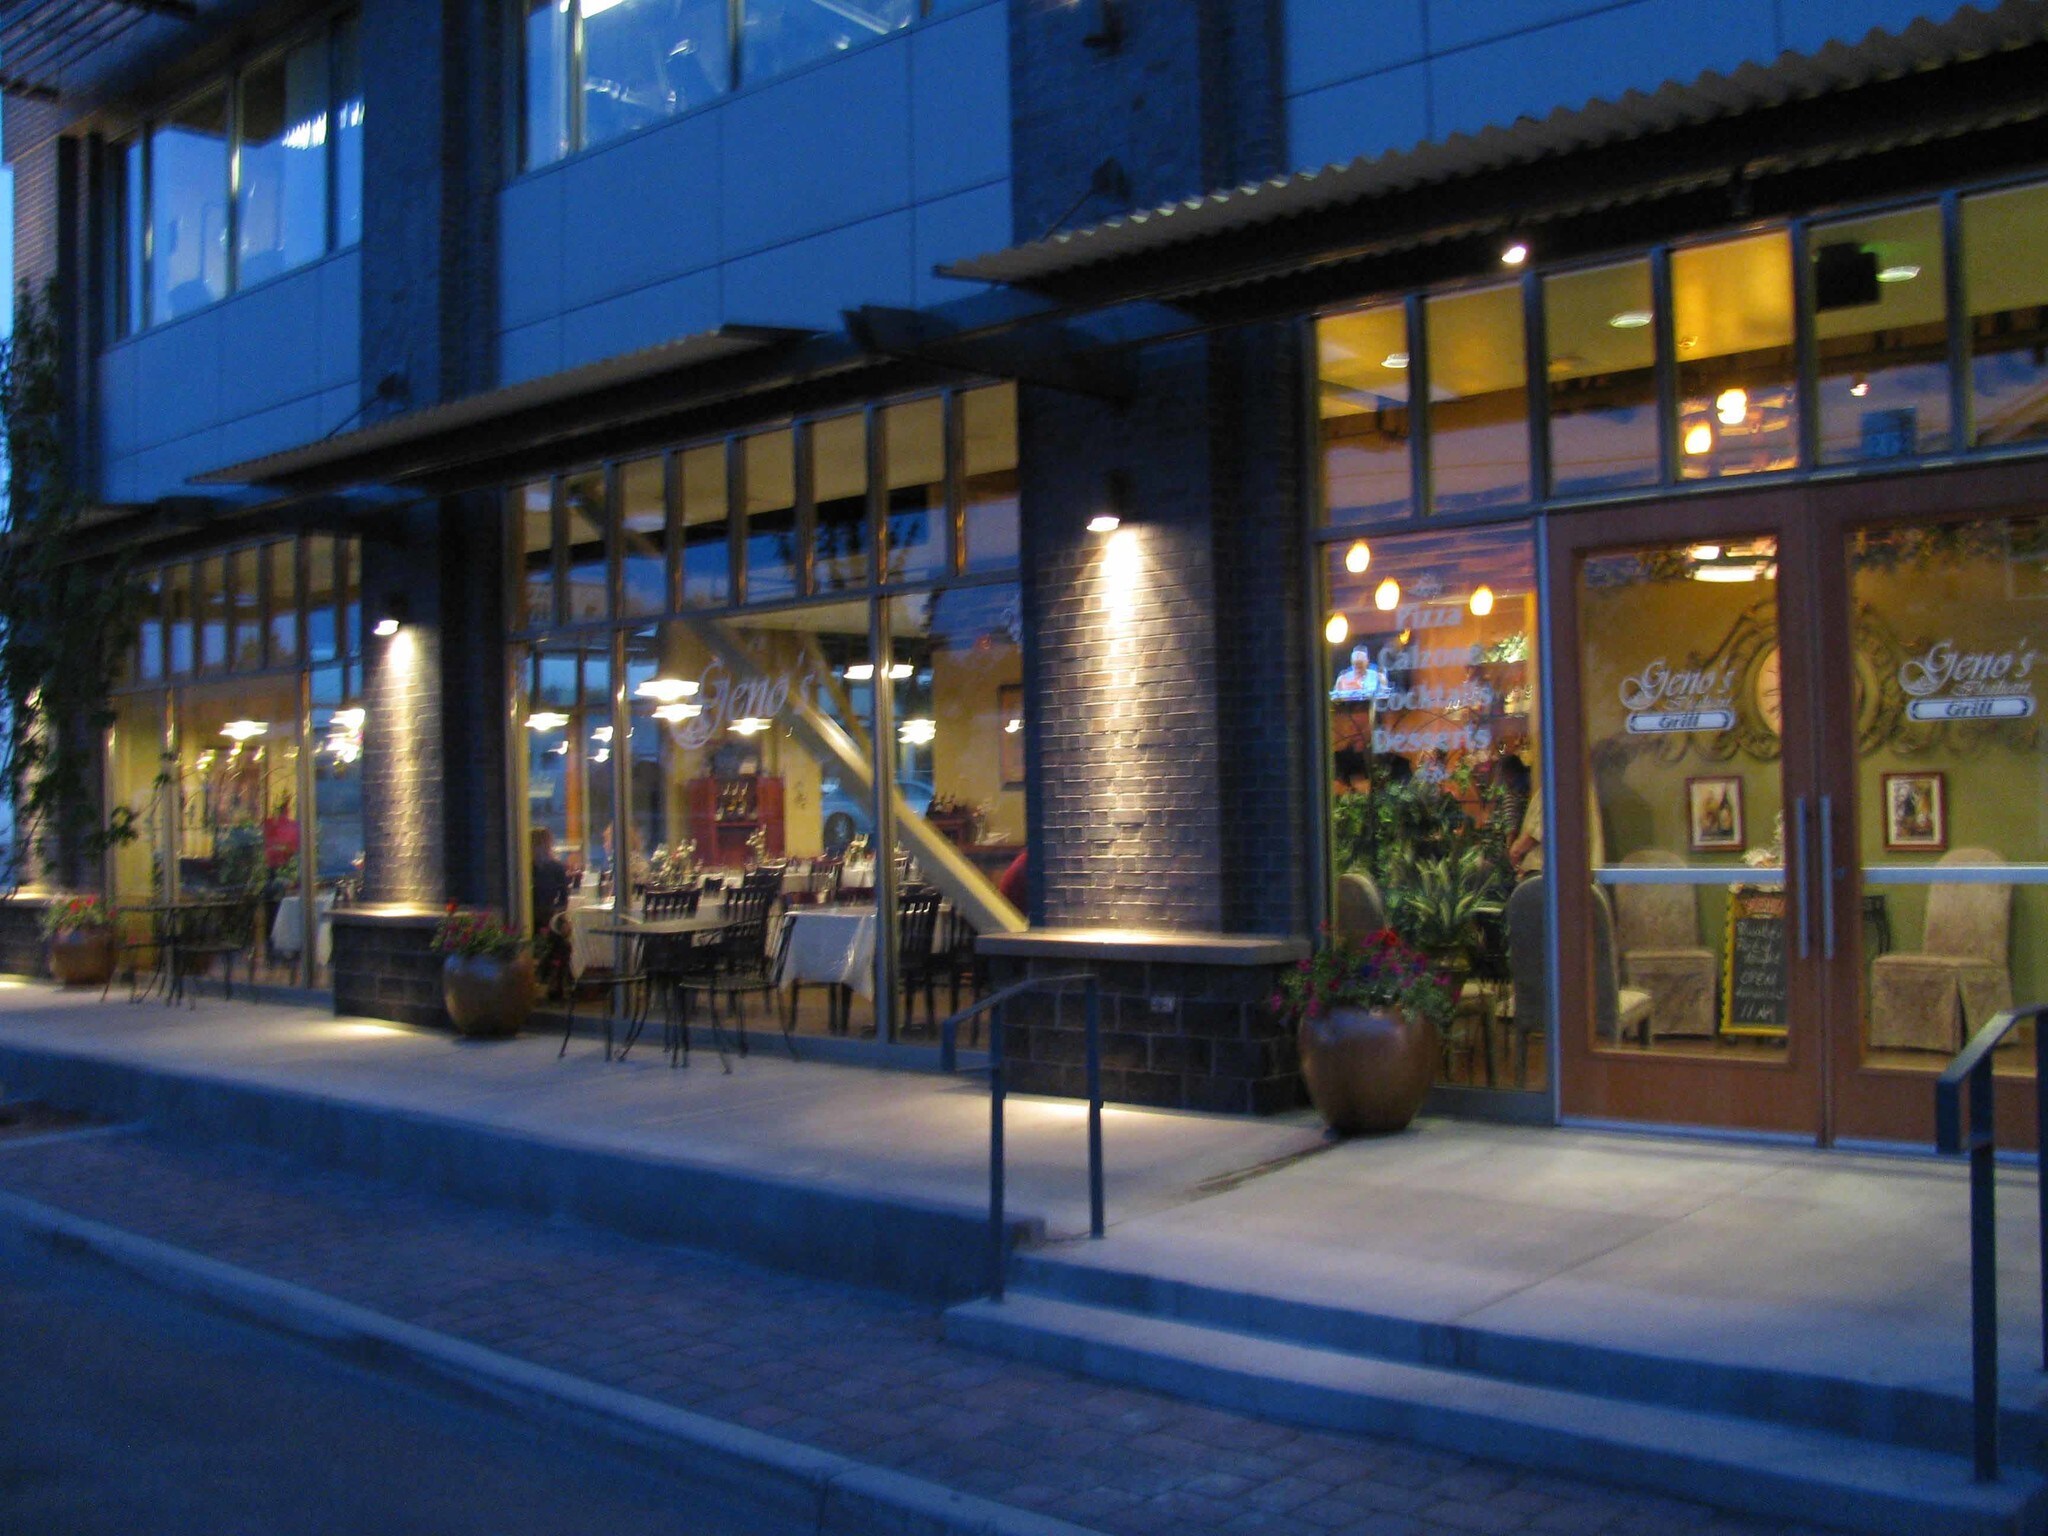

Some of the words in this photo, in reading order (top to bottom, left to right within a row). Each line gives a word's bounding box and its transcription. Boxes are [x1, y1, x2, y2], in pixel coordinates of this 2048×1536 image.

[1396, 603, 1463, 631] Pizza
[1900, 636, 2036, 695] Geno's
[672, 648, 816, 749] Geno's
[1619, 656, 1735, 710] Geno's
[1658, 713, 1700, 729] Grill
[1946, 699, 1993, 717] Grill
[1372, 723, 1491, 754] Desserts
